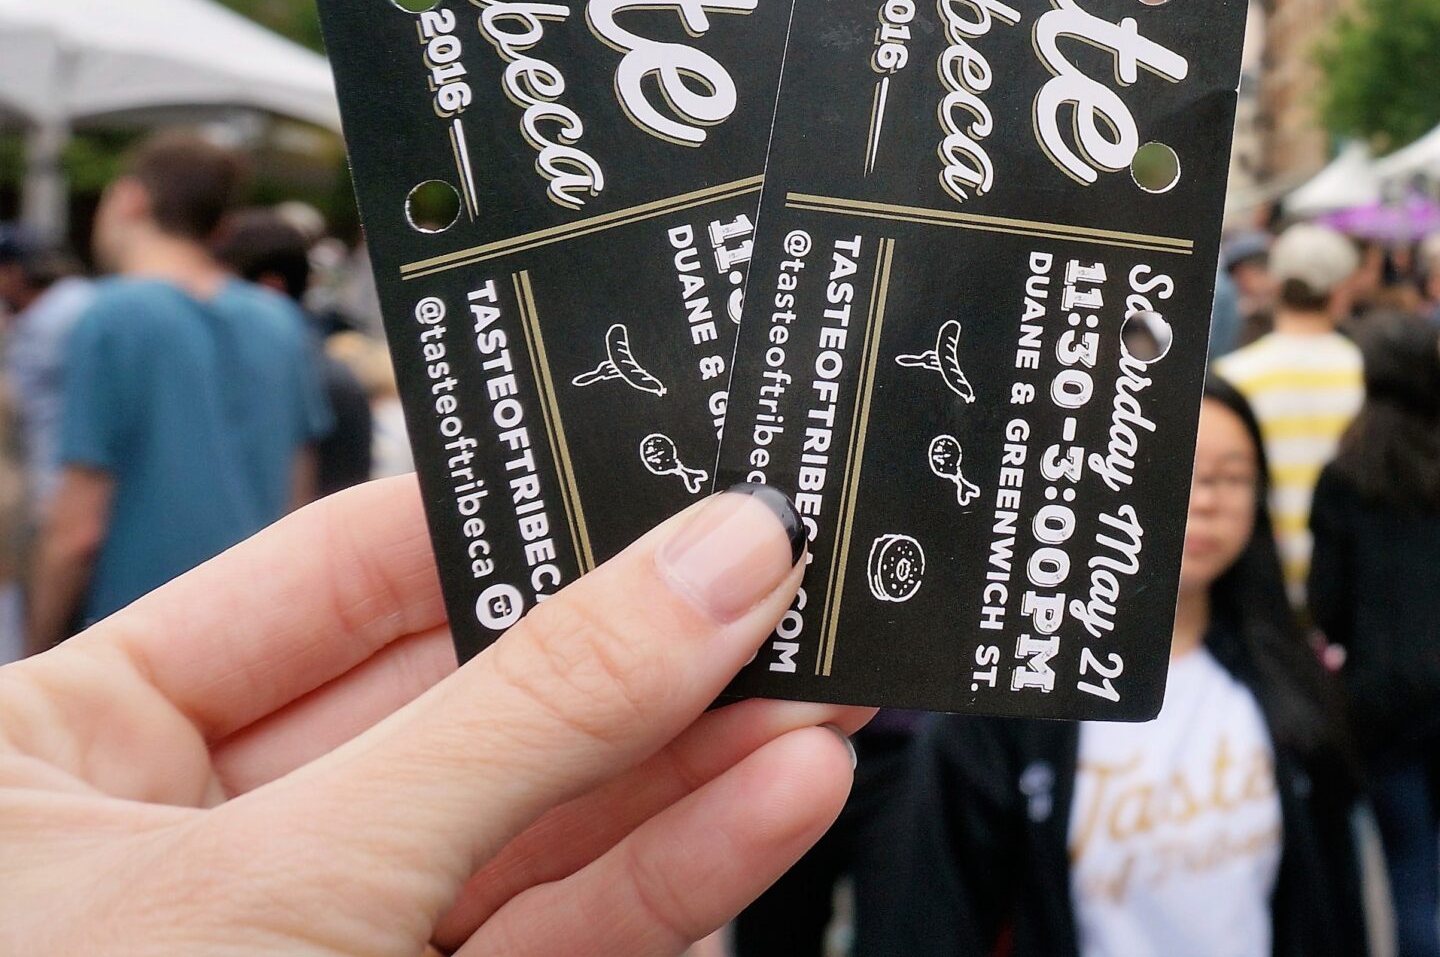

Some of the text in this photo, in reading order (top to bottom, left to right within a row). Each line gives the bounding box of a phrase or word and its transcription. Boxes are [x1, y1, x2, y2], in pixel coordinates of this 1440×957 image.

[419, 8, 472, 118] 2016
[668, 224, 718, 344] DUANE
[699, 355, 725, 380] &
[746, 229, 812, 485] @tasteoftribec
[414, 295, 494, 578] @tasteoftribeca
[466, 279, 561, 603] TASTEOFTRIBEC
[970, 251, 1053, 693] DUANE & GREENWICH ST.
[1069, 504, 1144, 638] May
[1076, 647, 1124, 702] 21
